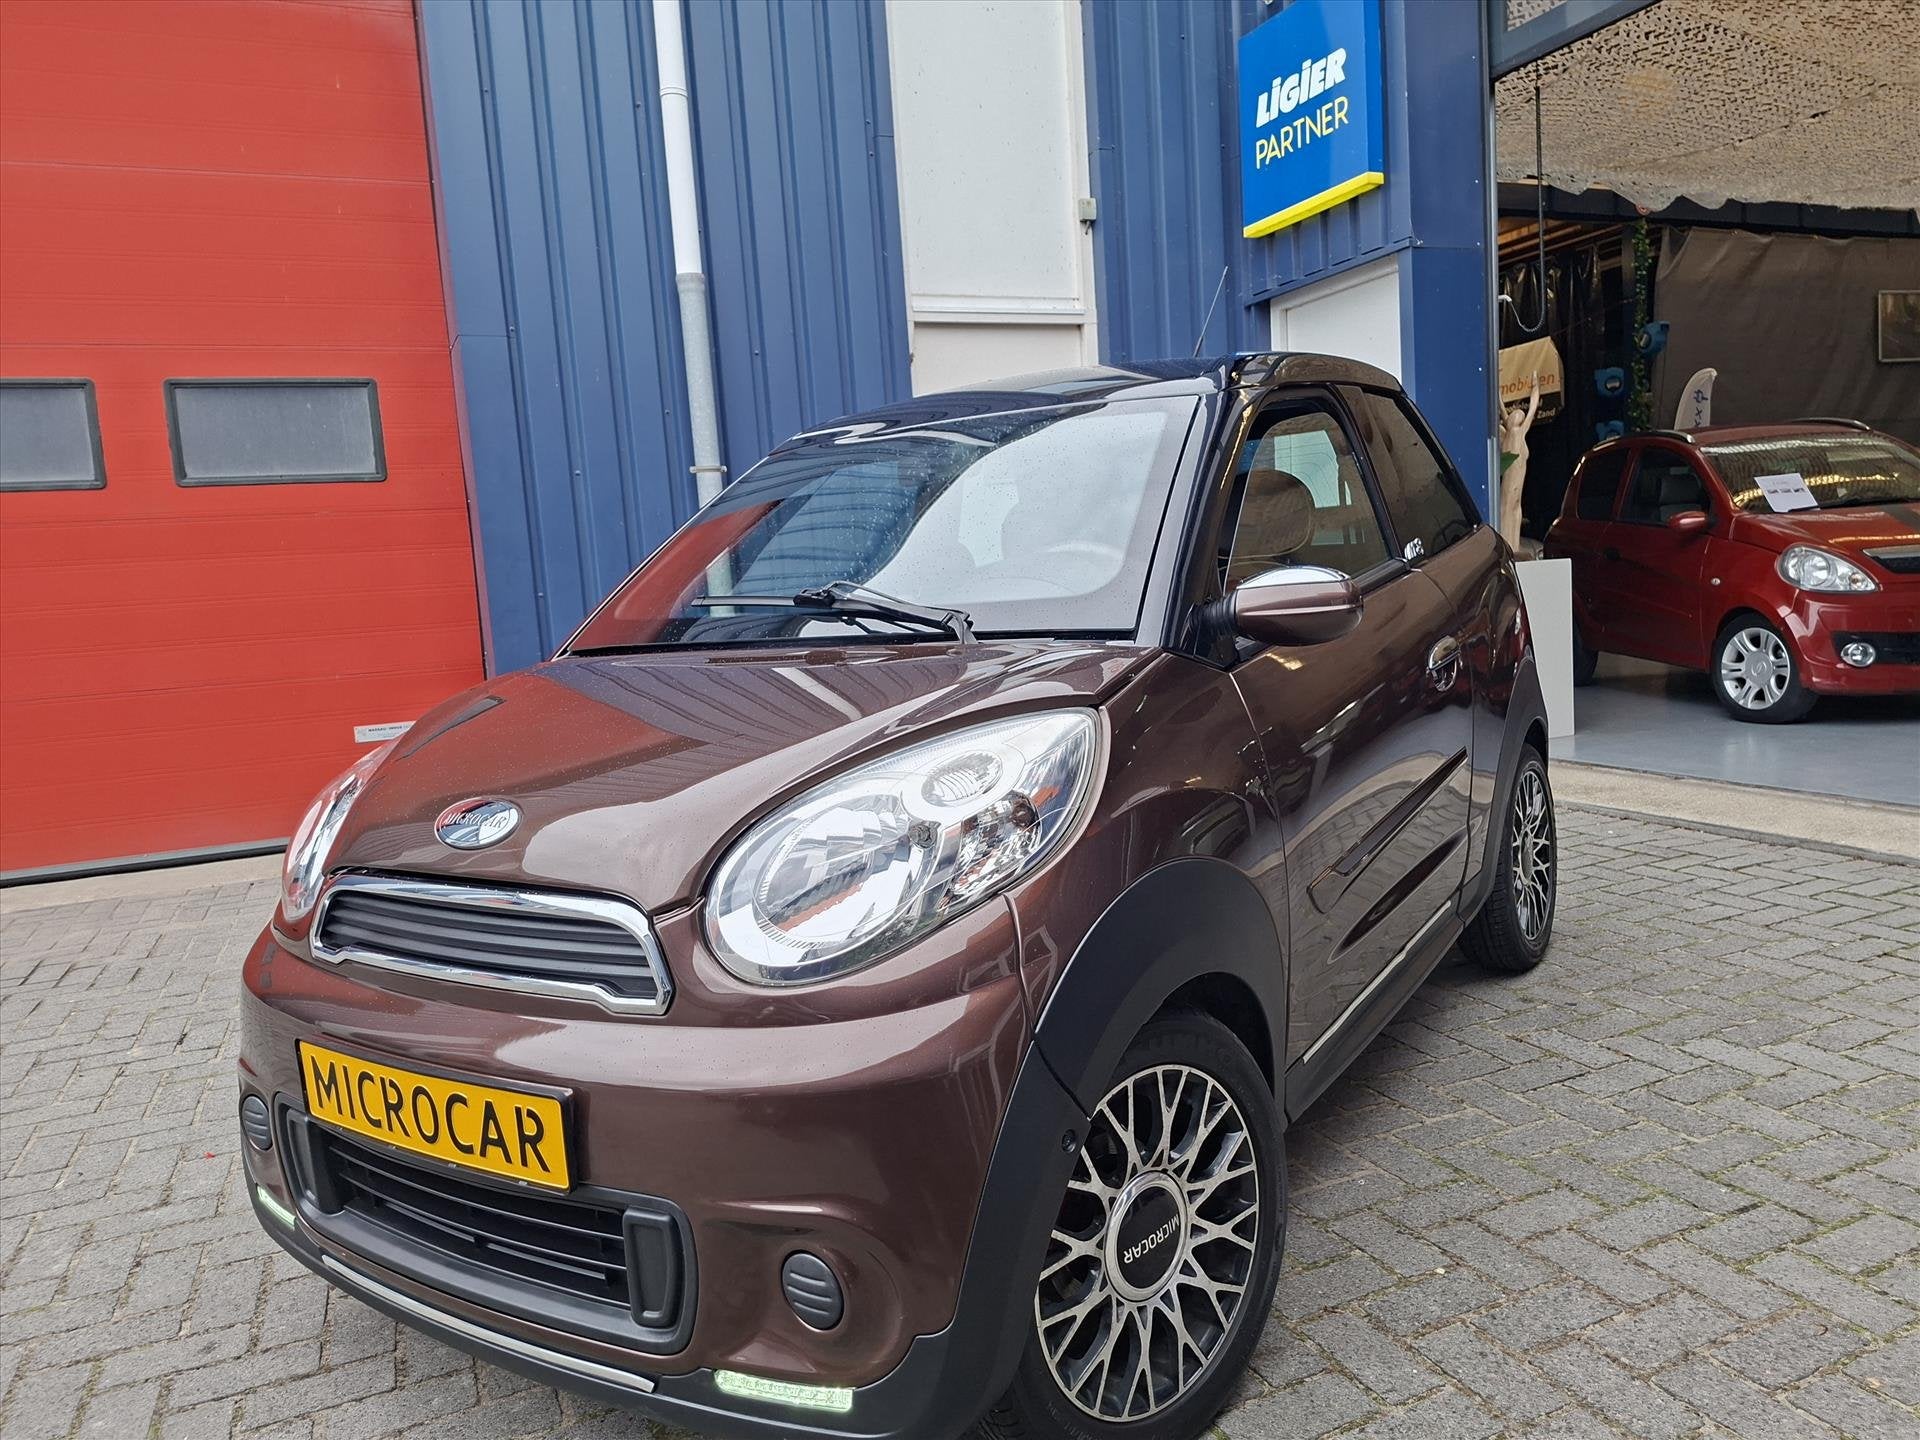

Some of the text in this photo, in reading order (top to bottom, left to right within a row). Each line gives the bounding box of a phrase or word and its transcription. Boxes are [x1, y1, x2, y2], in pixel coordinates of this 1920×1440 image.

[1256, 96, 1349, 169] PARTNER
[1500, 372, 1555, 395] mobien
[310, 1055, 551, 1172] MICROCAR
[1123, 1213, 1180, 1264] MICROCAR
